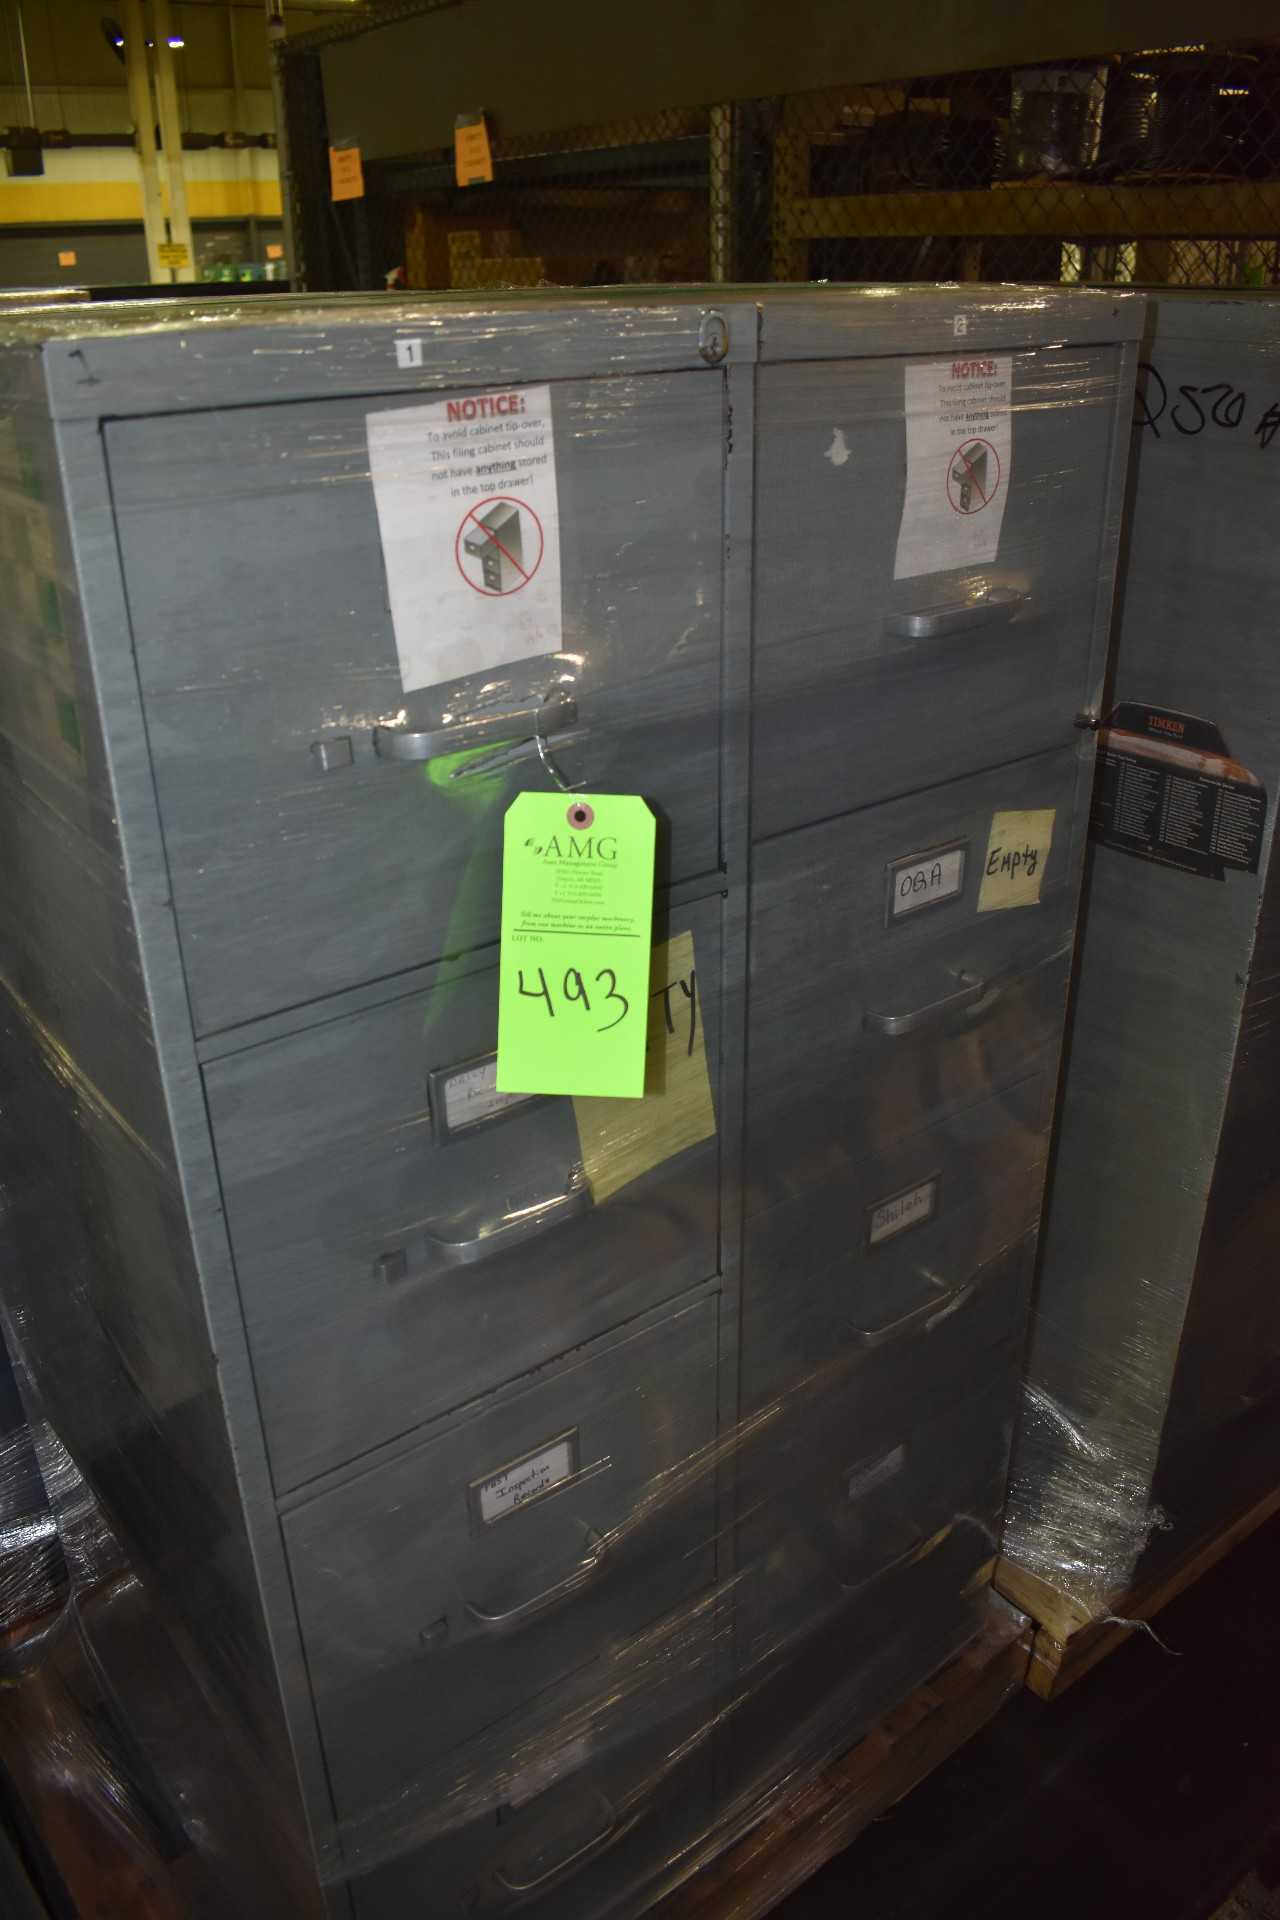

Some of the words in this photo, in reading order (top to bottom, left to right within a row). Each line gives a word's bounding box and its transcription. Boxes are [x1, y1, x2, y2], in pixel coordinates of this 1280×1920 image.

[951, 360, 998, 379] NOTICE:
[447, 394, 526, 422] NOTICE:
[428, 432, 440, 442] To
[443, 426, 468, 441] avoid
[469, 423, 503, 436] cabinet
[431, 450, 450, 461] This
[453, 447, 476, 459] filing
[478, 442, 512, 455] cabinet
[513, 435, 545, 449] should
[431, 471, 448, 481] not
[450, 467, 473, 478] have
[475, 460, 517, 476] anything
[518, 454, 548, 466] stored
[451, 487, 460, 497] in
[462, 485, 478, 495] the
[480, 483, 496, 494] top
[544, 835, 618, 861] AMG
[518, 967, 629, 1032] 493
